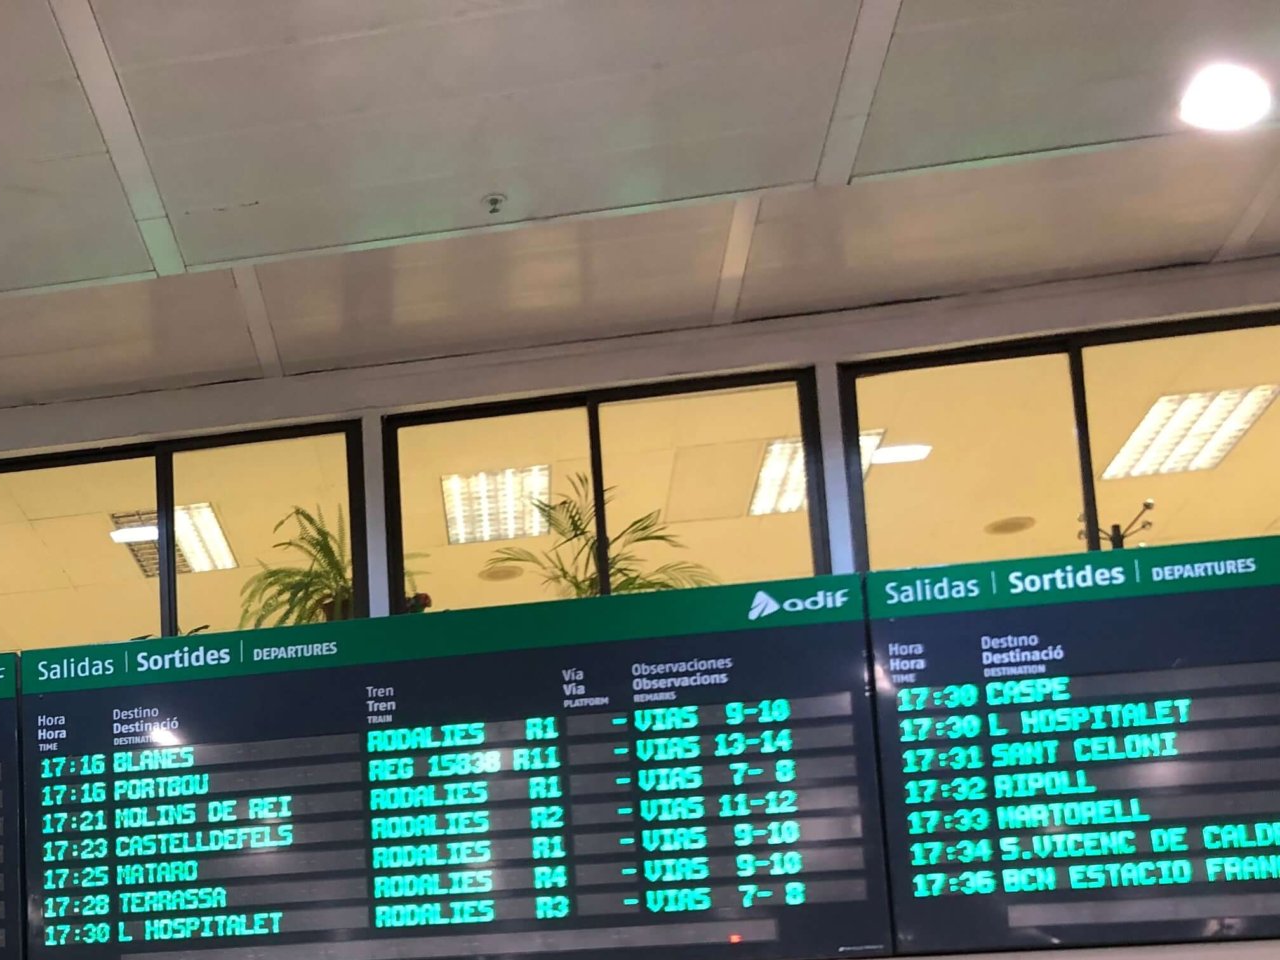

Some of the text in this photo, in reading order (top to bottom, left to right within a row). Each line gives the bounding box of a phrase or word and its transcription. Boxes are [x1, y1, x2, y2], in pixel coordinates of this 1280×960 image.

[885, 557, 1257, 605] Salidas Sortides DEPARTURES
[782, 589, 849, 612] adif
[888, 641, 925, 656] Hora
[981, 633, 1039, 650] Destino
[37, 641, 338, 681] Salidas Sortides DEPARTURES
[889, 656, 927, 671] Hora
[981, 644, 1065, 666] Destinació
[562, 668, 584, 681] Vía
[632, 656, 734, 677] Observaciones
[983, 664, 1046, 678] DESTINATION
[632, 672, 729, 691] Observacions
[892, 674, 917, 683] TIME
[366, 686, 394, 698] Tren
[563, 696, 609, 708] PLATFORM
[633, 691, 676, 703] REMARKS
[896, 676, 1071, 712] 17:30 CASPE
[113, 706, 159, 721] Destino
[367, 699, 396, 712] Tren
[37, 714, 66, 727] Hora
[113, 717, 179, 735] Destinació
[367, 714, 392, 724] TRAIN
[899, 698, 1192, 742] 17:30 L HOSPITALET
[37, 727, 67, 741] Hora
[40, 698, 791, 779] 17:16 BLANES RODALIES R1 VIAS 9-10
[39, 742, 58, 752] TIME
[901, 731, 1179, 773] 17:31 SANT CELONI
[41, 782, 106, 807] 17:16
[114, 774, 209, 801] PORTBOU
[368, 757, 414, 782] REG
[512, 746, 561, 771] R11
[635, 735, 701, 762] VIAS
[714, 728, 793, 757] 13-14
[904, 770, 1097, 804] 17:32 RIPOLL
[42, 796, 293, 834] 17:21 MOLINS DE REI
[906, 798, 1151, 835] 17:33 MARTORELL
[43, 790, 799, 862] 17:23 CASTELLDEFELS RODALIES R2 VIAS 11-12
[909, 838, 993, 866] 17:34
[999, 830, 1137, 862] S.VICENC
[1150, 826, 1189, 853] DE
[43, 860, 198, 890] 17:25 MATARO
[912, 855, 1280, 898] 17:36 BCN ESTACIO FRAN
[44, 887, 227, 918] 17:28 TERRASSA
[44, 912, 284, 946] 17:30 L HOSPITALET
